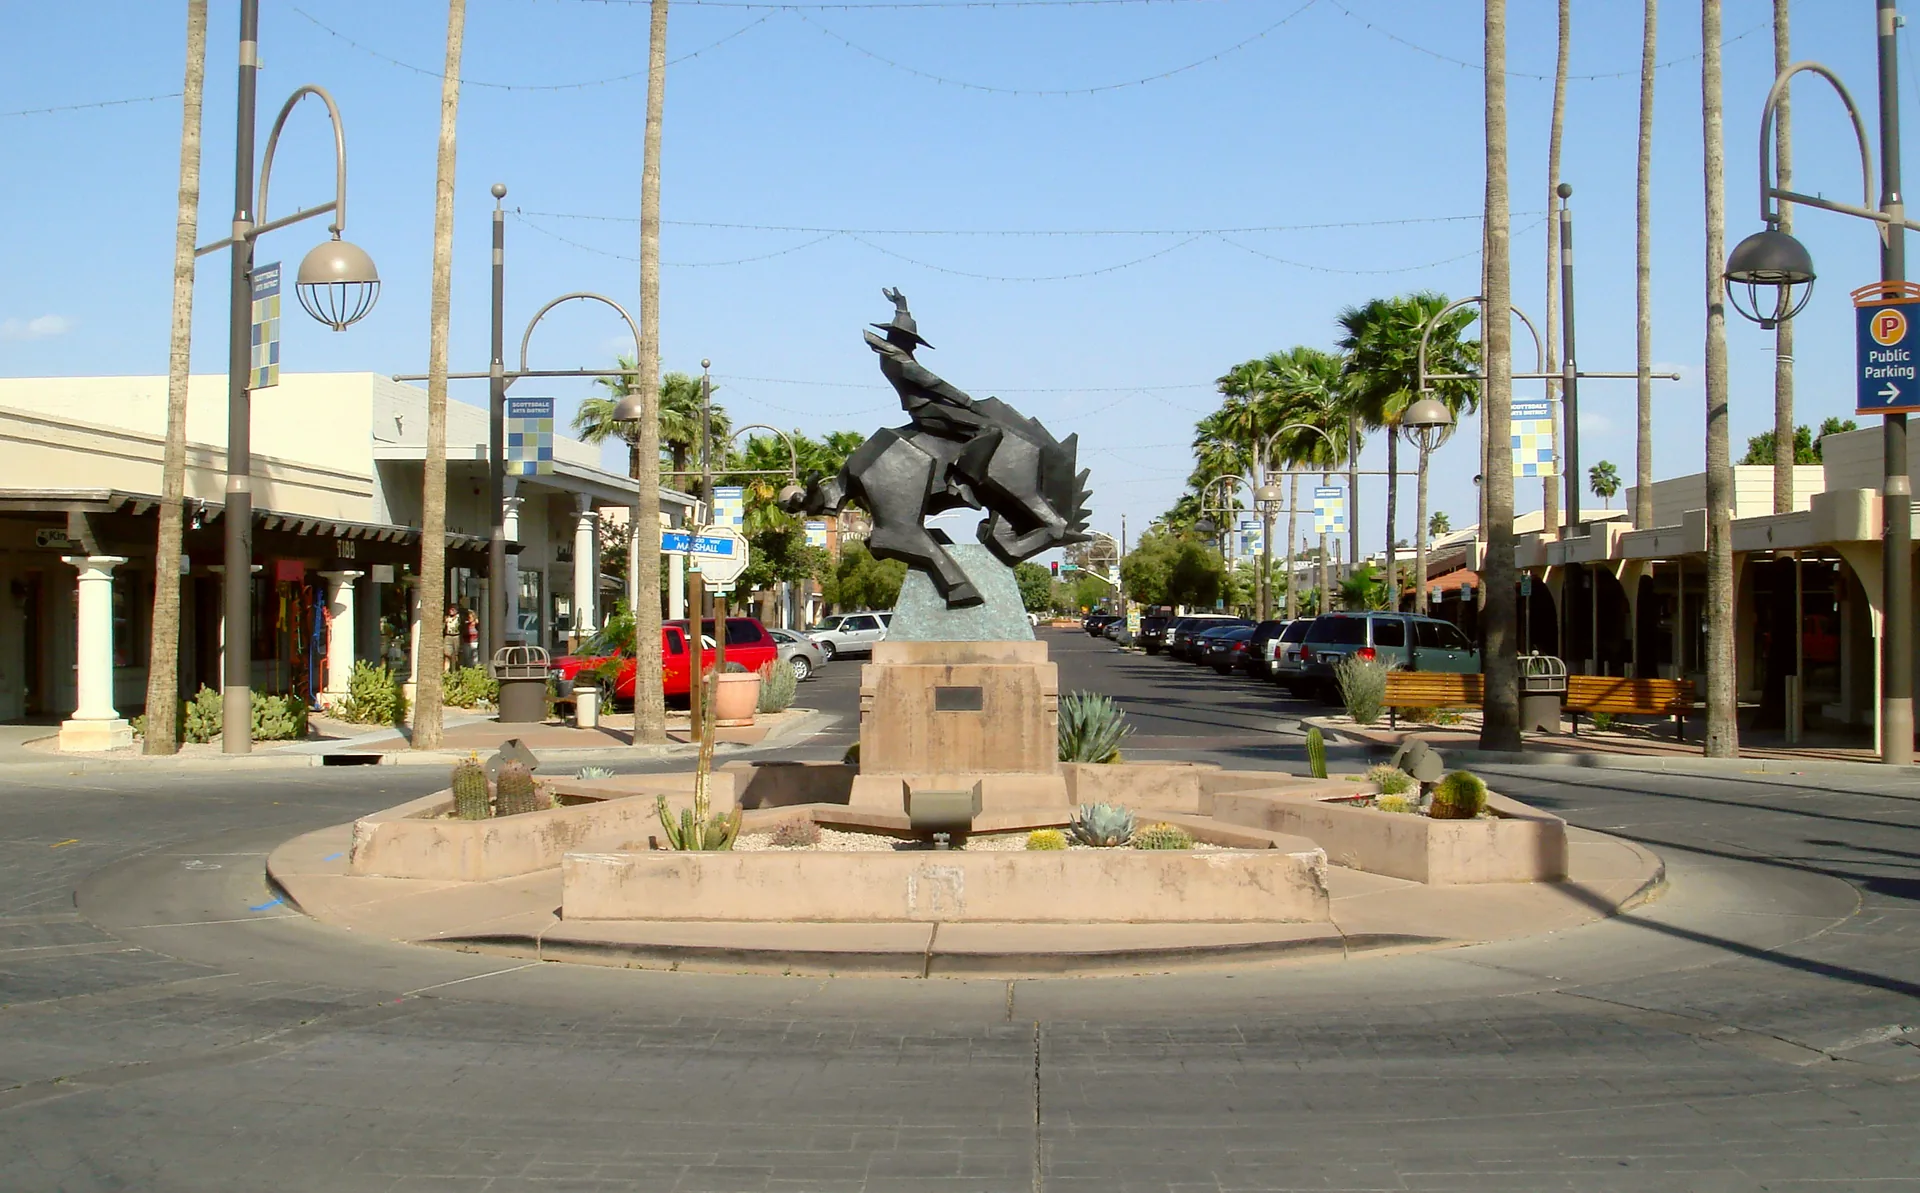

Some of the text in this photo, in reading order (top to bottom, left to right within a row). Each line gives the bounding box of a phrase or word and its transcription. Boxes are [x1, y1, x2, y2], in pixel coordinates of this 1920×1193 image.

[1880, 316, 1899, 339] P
[1869, 349, 1910, 363] Public
[1865, 365, 1915, 380] Parking
[676, 542, 719, 552] MARSHALL
